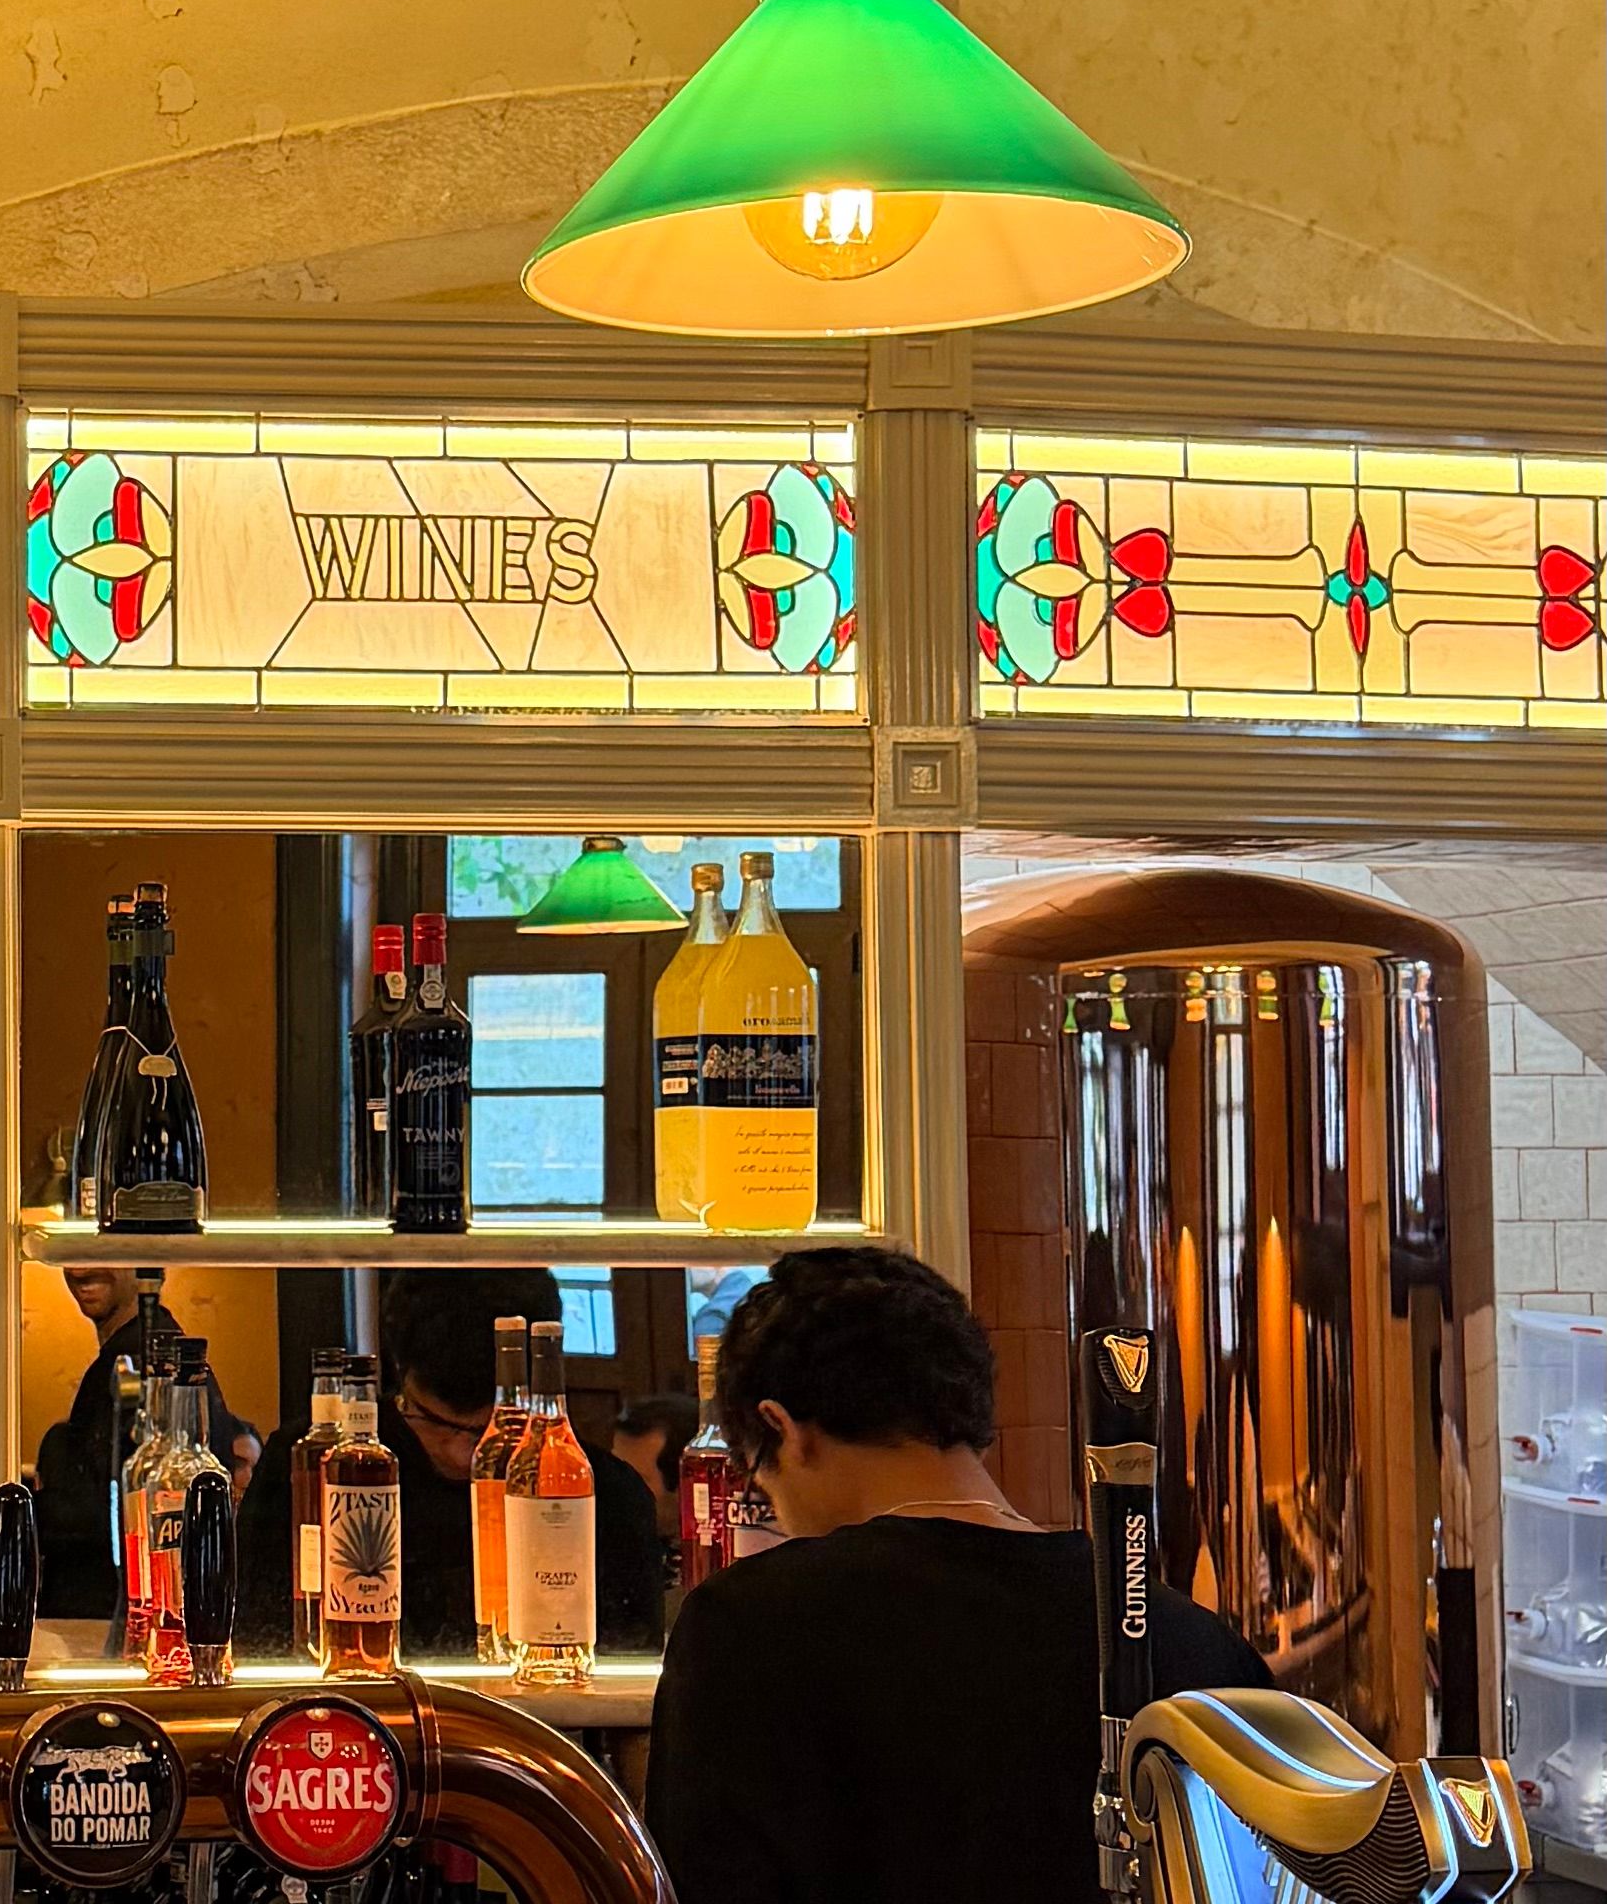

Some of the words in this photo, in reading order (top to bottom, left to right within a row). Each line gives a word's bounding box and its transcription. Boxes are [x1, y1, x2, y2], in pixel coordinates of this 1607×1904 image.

[294, 513, 599, 605] WINES
[402, 1127, 466, 1144] TAWNY
[1122, 1513, 1147, 1639] GUINNESS
[50, 1781, 151, 1815] BANDIDA
[251, 1763, 393, 1814] SAGRES
[51, 1817, 76, 1842] DO
[83, 1815, 151, 1843] POMAR
